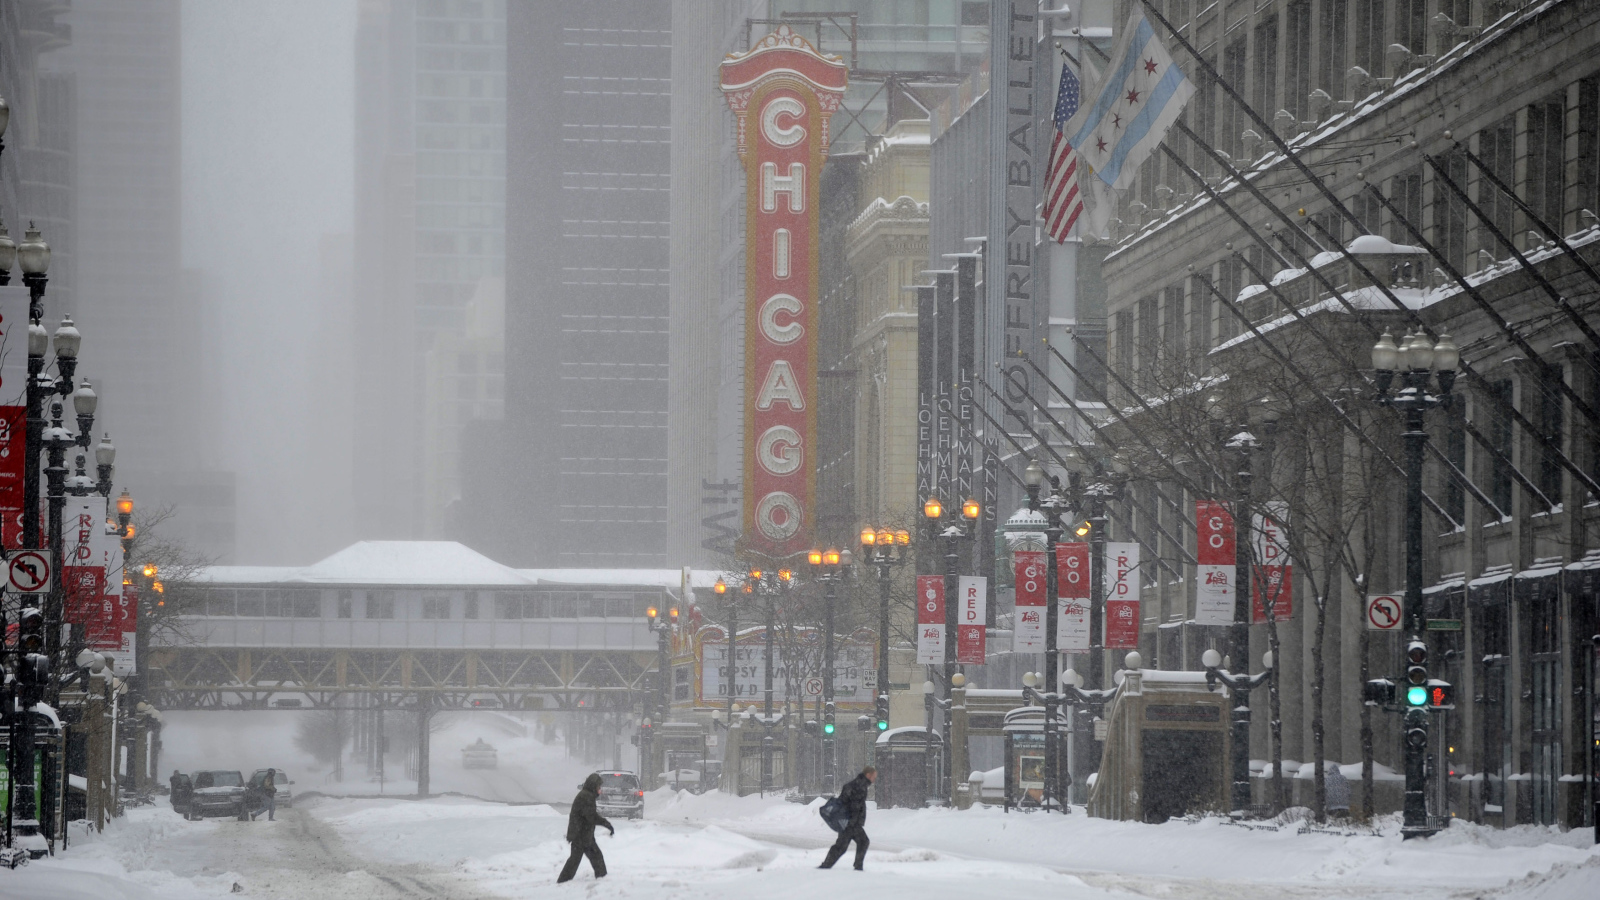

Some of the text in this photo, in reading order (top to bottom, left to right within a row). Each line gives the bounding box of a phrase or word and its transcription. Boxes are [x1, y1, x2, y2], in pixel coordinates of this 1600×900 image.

[1006, 2, 1033, 431] JOFFREY BALLET
[755, 97, 807, 542] CHICAGO
[937, 381, 952, 532] LOEHMANN
[77, 513, 92, 560] RED
[1208, 516, 1224, 548] GO
[1265, 514, 1279, 559] RED
[1025, 566, 1037, 593] GO
[1066, 556, 1080, 584] GO
[1117, 556, 1129, 595] RED
[966, 587, 977, 621] RED
[718, 665, 758, 678] GPSY
[719, 648, 753, 660] TEY
